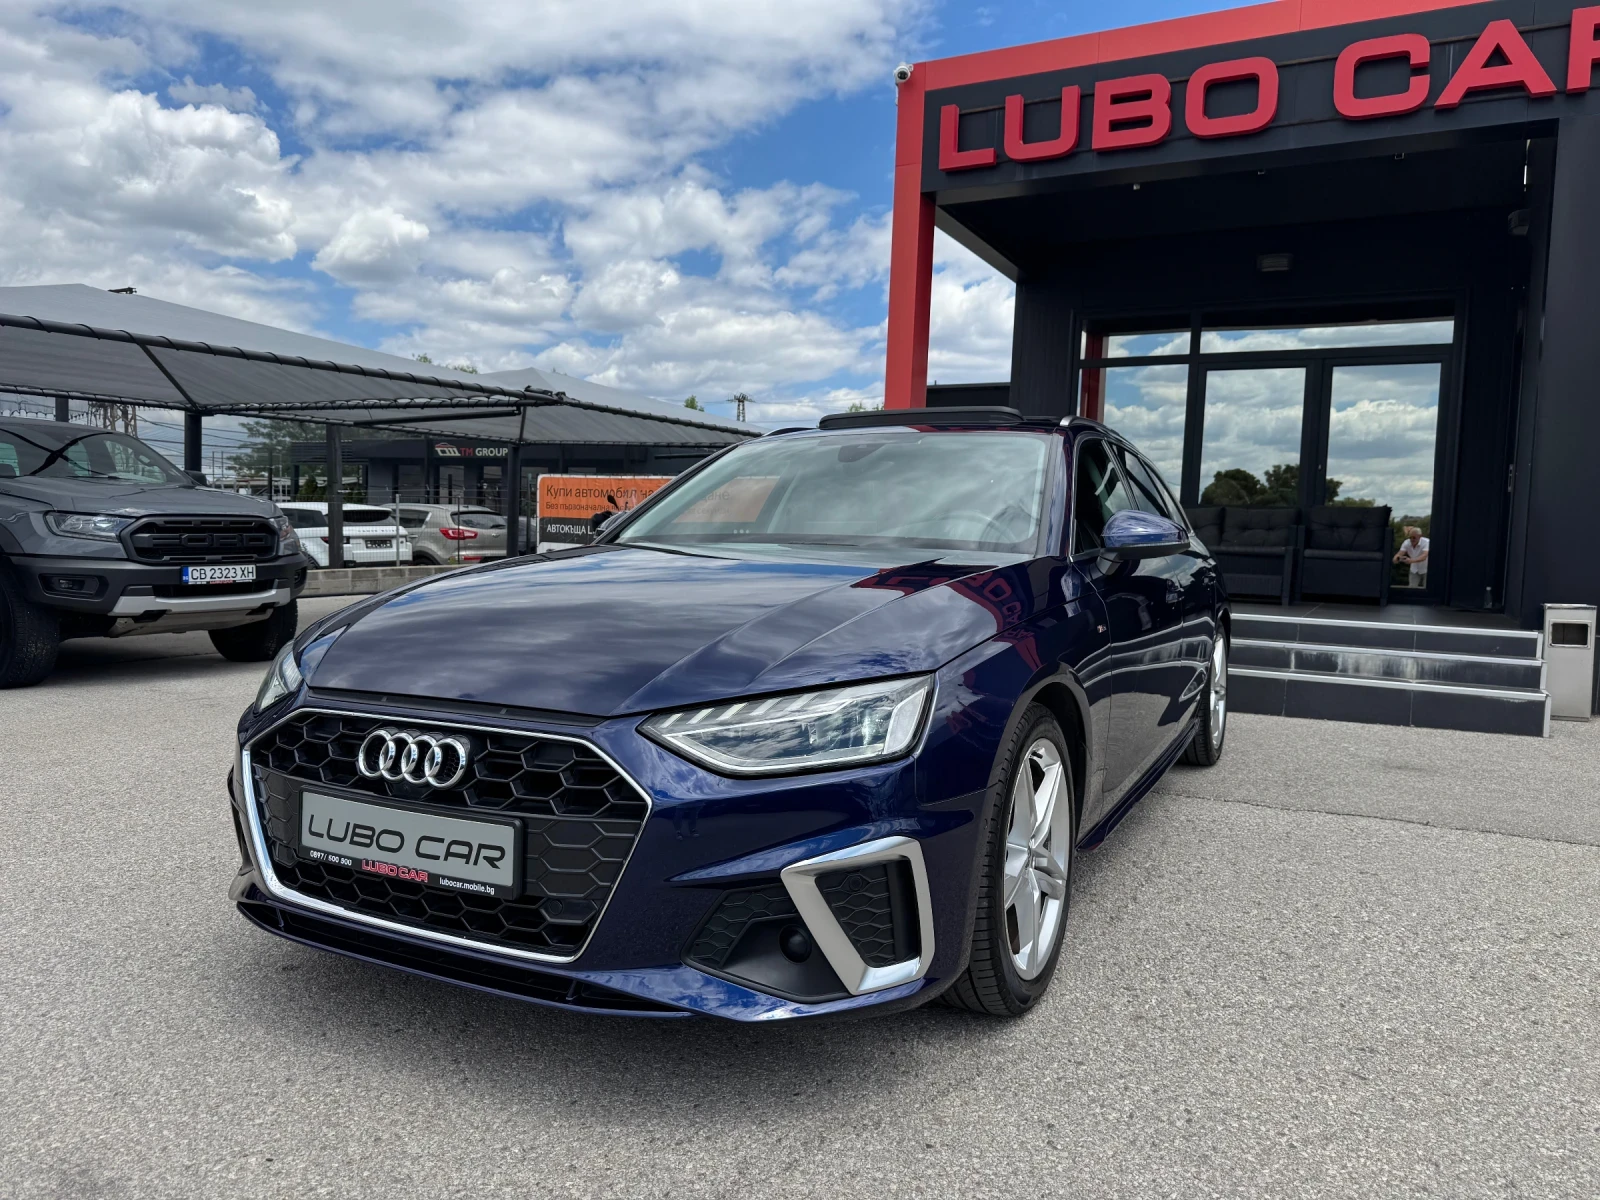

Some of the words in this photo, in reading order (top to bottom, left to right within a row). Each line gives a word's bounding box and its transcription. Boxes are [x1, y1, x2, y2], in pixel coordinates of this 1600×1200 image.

[939, 56, 1279, 171] LUBO
[475, 447, 508, 456] GROUP
[546, 485, 572, 501] Купи
[575, 487, 637, 499] автомобил
[546, 524, 586, 534] АВТОКЪЩА
[191, 568, 207, 580] CB
[209, 567, 238, 580] 2323
[240, 566, 255, 579] XH
[308, 814, 405, 853] LUBO
[415, 835, 506, 869] CAR
[361, 859, 397, 877] LUBO
[398, 866, 428, 883] CAR
[439, 877, 495, 895] lubocar.mobile.bg
